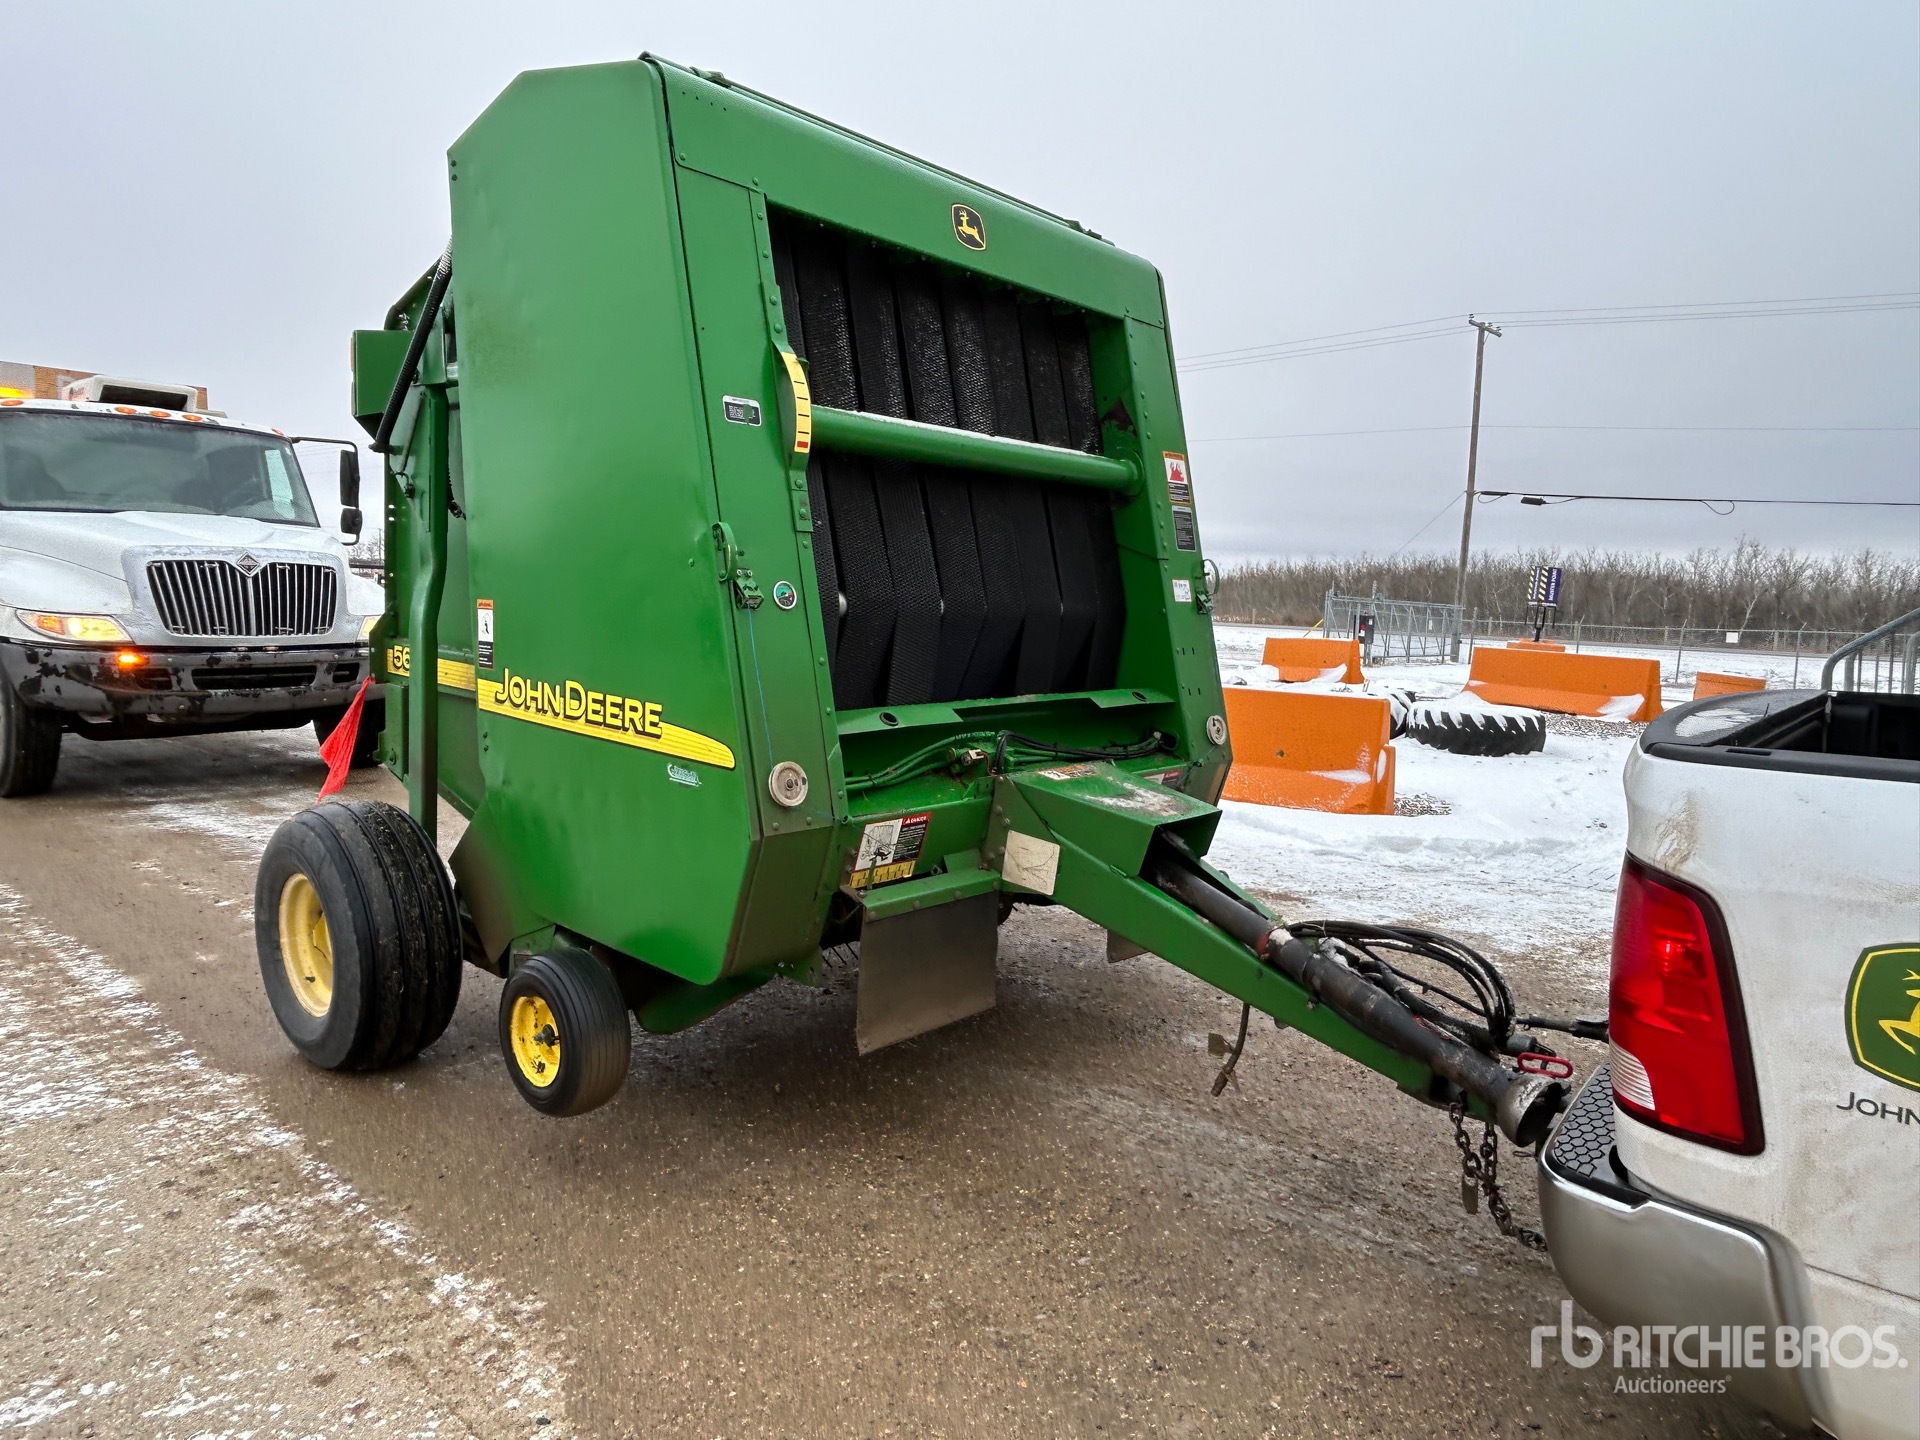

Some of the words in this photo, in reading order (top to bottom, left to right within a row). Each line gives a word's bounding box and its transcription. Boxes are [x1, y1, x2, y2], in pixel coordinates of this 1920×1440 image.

[1548, 583, 1556, 601] MUSTER
[495, 667, 560, 718] JOHN
[564, 679, 663, 740] DEERE
[1836, 1091, 1920, 1125] JOHN
